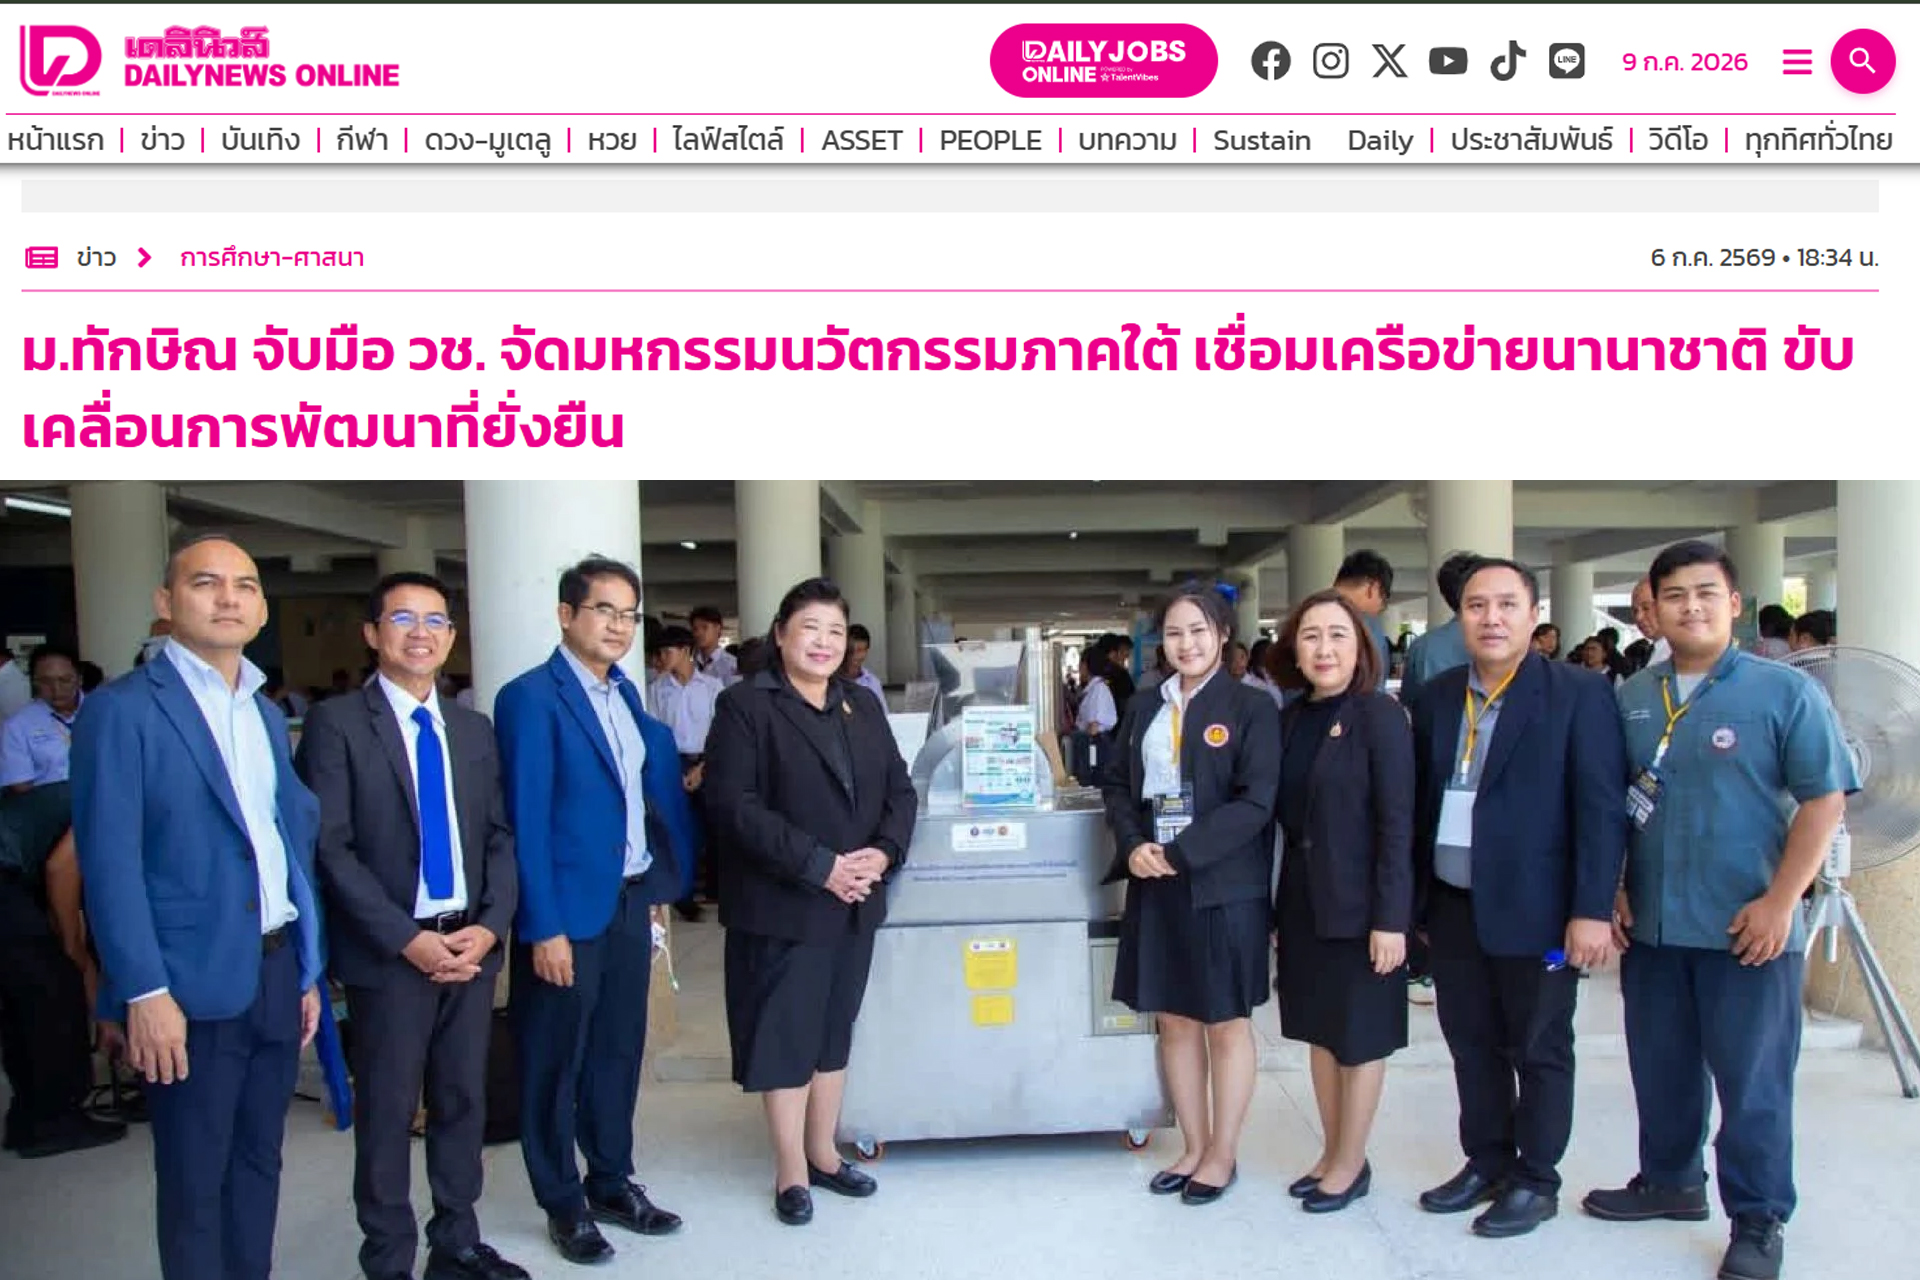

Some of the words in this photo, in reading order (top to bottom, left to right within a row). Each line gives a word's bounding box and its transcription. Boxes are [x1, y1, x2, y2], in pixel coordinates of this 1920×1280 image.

[125, 25, 270, 59] เดลินิวส์
[125, 64, 286, 86] DAILYNEWS
[296, 64, 399, 86] ONLINE
[1022, 66, 1097, 83] ONLINE
[1623, 53, 1636, 71] 9
[1644, 54, 1684, 71] ก.ค.
[1691, 53, 1748, 71] 2026
[1111, 73, 1159, 81] TalentVibes
[8, 125, 103, 151] หน้าแรก
[141, 125, 185, 151] ข่าว
[222, 125, 301, 151] บันเทิง
[337, 125, 388, 151] กีฬา
[425, 132, 551, 158] ดวง-มูเตลู
[588, 132, 637, 151] หวย
[673, 125, 784, 151] ไลฟ์สไตล์
[822, 130, 903, 150] ASSET
[941, 130, 1042, 150] PEOPLE
[1079, 132, 1177, 151] บทความ
[1213, 130, 1311, 151] Sustain
[1348, 130, 1414, 156] Daily
[1451, 125, 1614, 151] ประชาสัมพันธ์
[1648, 125, 1709, 151] วิดีโอ
[1745, 120, 1893, 158] ทุกทิศทั่วไทย
[77, 246, 117, 267] ข่าว
[180, 245, 364, 267] การศึกษา-ศาสนา
[1651, 249, 1665, 267] 6
[1672, 250, 1713, 267] ก.ค.
[1720, 249, 1776, 267] 2569
[1797, 248, 1853, 267] 18:34
[1859, 250, 1880, 267] น.
[23, 323, 237, 371] ม.ทักษิณ
[252, 323, 395, 371] จับมือ
[409, 336, 486, 371] วช.
[500, 322, 1182, 371] จัดมหกรรมนวัตกรรมภาคใต้
[1195, 313, 1767, 371] เชื่อมเครือข่ายนานาชาติ
[1783, 323, 1854, 371] ขับ
[23, 389, 624, 448] เคลื่อนการพัฒนาที่ยั่งยืน
